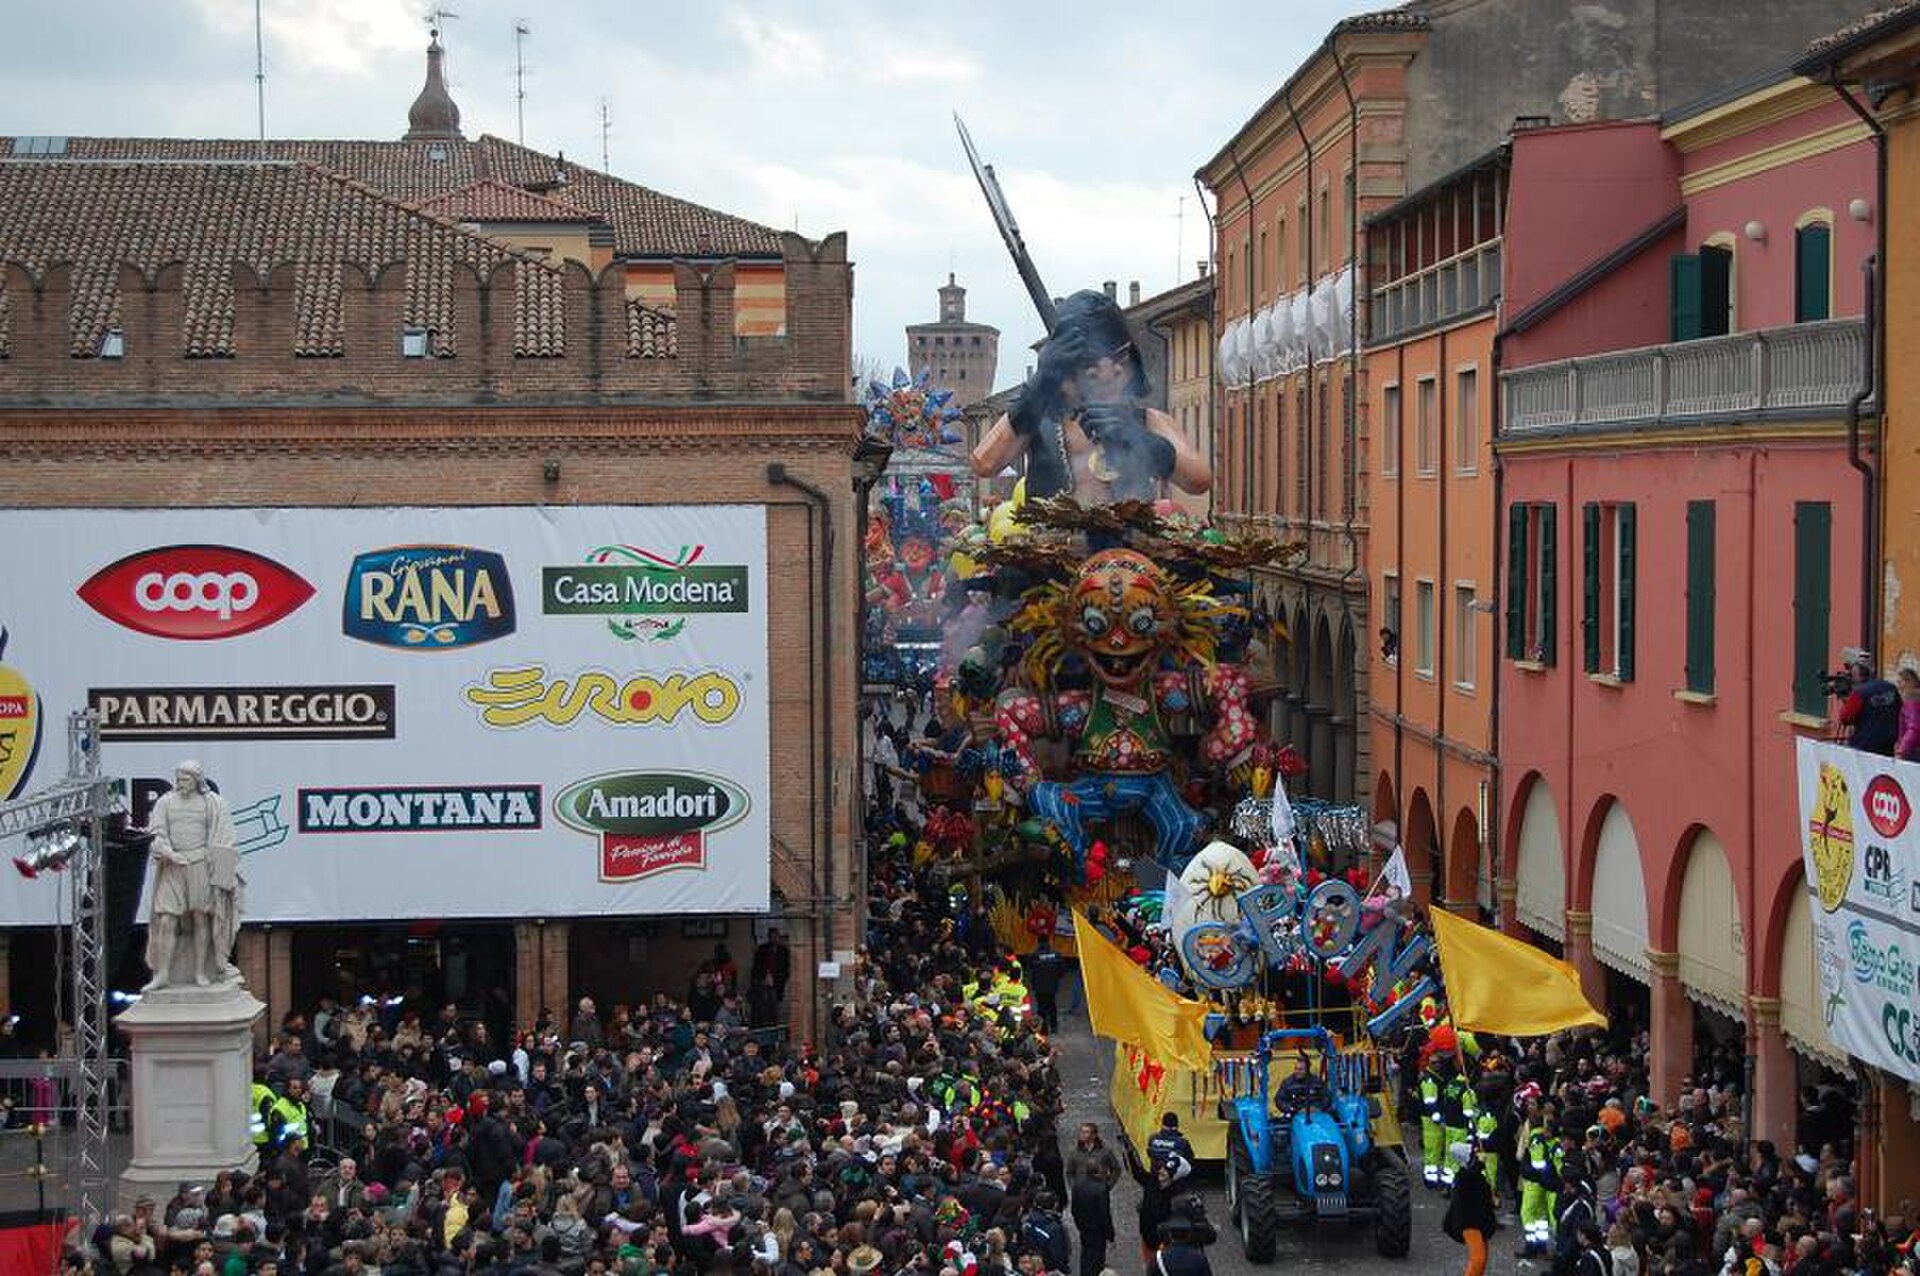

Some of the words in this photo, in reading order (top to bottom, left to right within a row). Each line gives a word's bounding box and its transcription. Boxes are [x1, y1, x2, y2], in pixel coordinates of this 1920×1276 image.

[361, 568, 502, 622] RANA
[555, 575, 619, 604] Casa
[624, 575, 735, 604] Modena
[100, 692, 376, 726] PARMAREGGIO
[305, 790, 537, 829] MONTANA
[587, 786, 717, 818] Amadori
